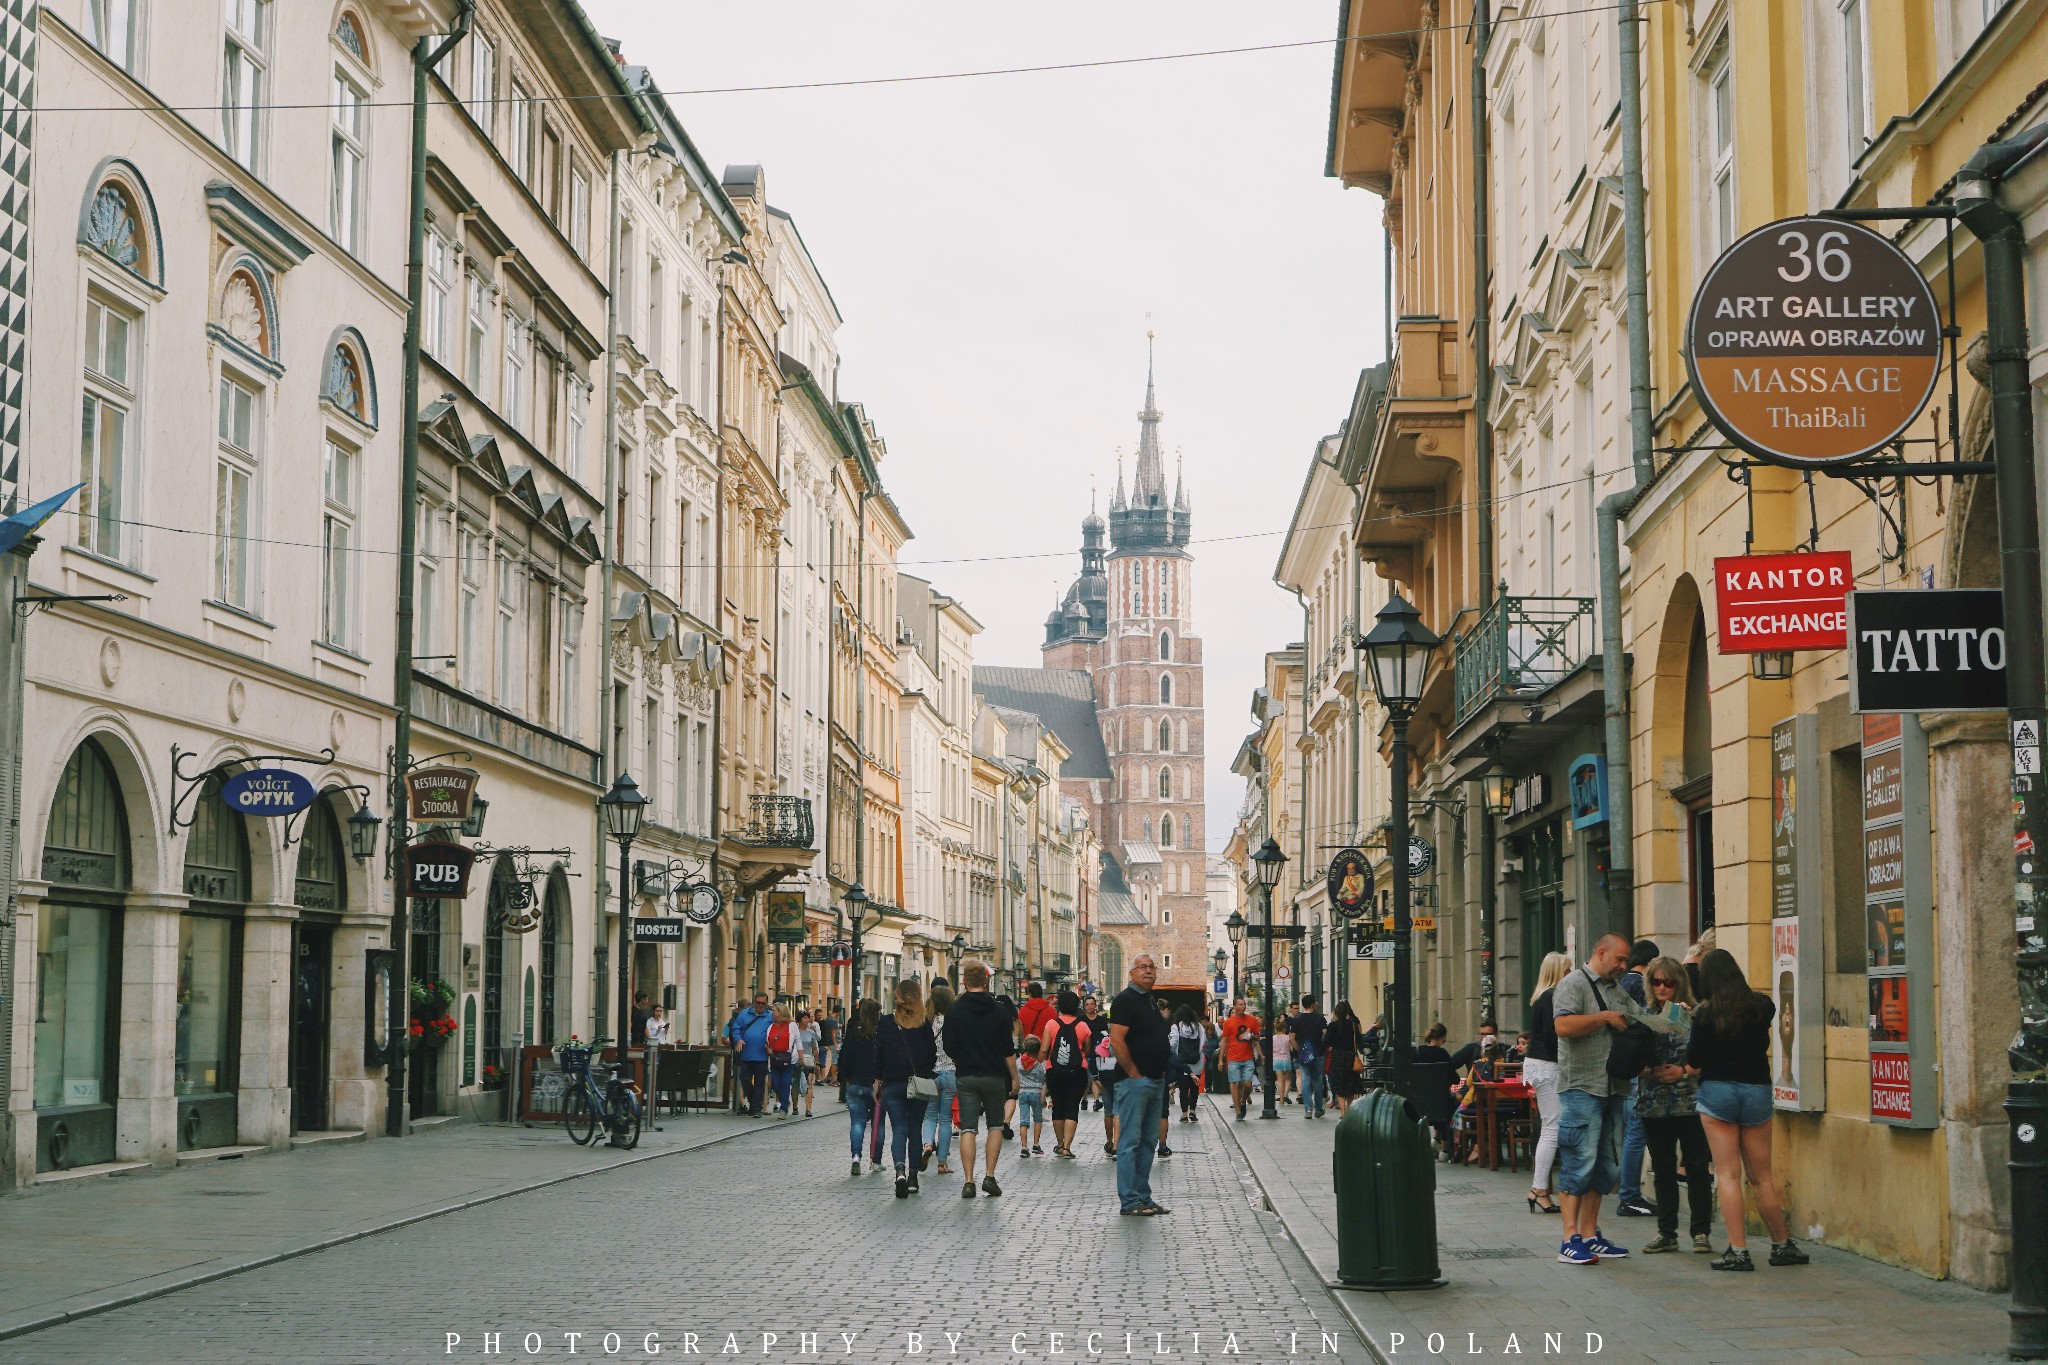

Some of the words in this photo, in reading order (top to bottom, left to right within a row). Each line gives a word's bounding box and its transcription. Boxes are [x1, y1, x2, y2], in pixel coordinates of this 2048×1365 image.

[1777, 231, 1851, 282] 36
[1715, 296, 1773, 319] ART
[1782, 296, 1916, 318] GALLERY
[1708, 331, 1805, 349] OPRAWA
[1810, 325, 1925, 347] OBRAZÓW
[1732, 367, 1902, 393] MASSAGE
[1766, 406, 1866, 428] ThaiBali
[1726, 567, 1844, 591] KANTOR
[1730, 612, 1847, 636] EXCHANGE
[413, 776, 467, 790] RESTAURACJA
[1872, 765, 1884, 785] ART
[239, 791, 294, 806] OPTYK
[1872, 782, 1901, 807] GALLERY
[421, 799, 459, 814] STODOŁA
[1868, 834, 1902, 860] OPRAWA
[414, 863, 460, 883] PUB
[1869, 858, 1902, 885] OBRAZÓW
[636, 924, 681, 936] HOSTEL
[1217, 980, 1225, 992] P
[1872, 1059, 1909, 1081] KANTOR
[1872, 1089, 1911, 1112] EXCHANGE
